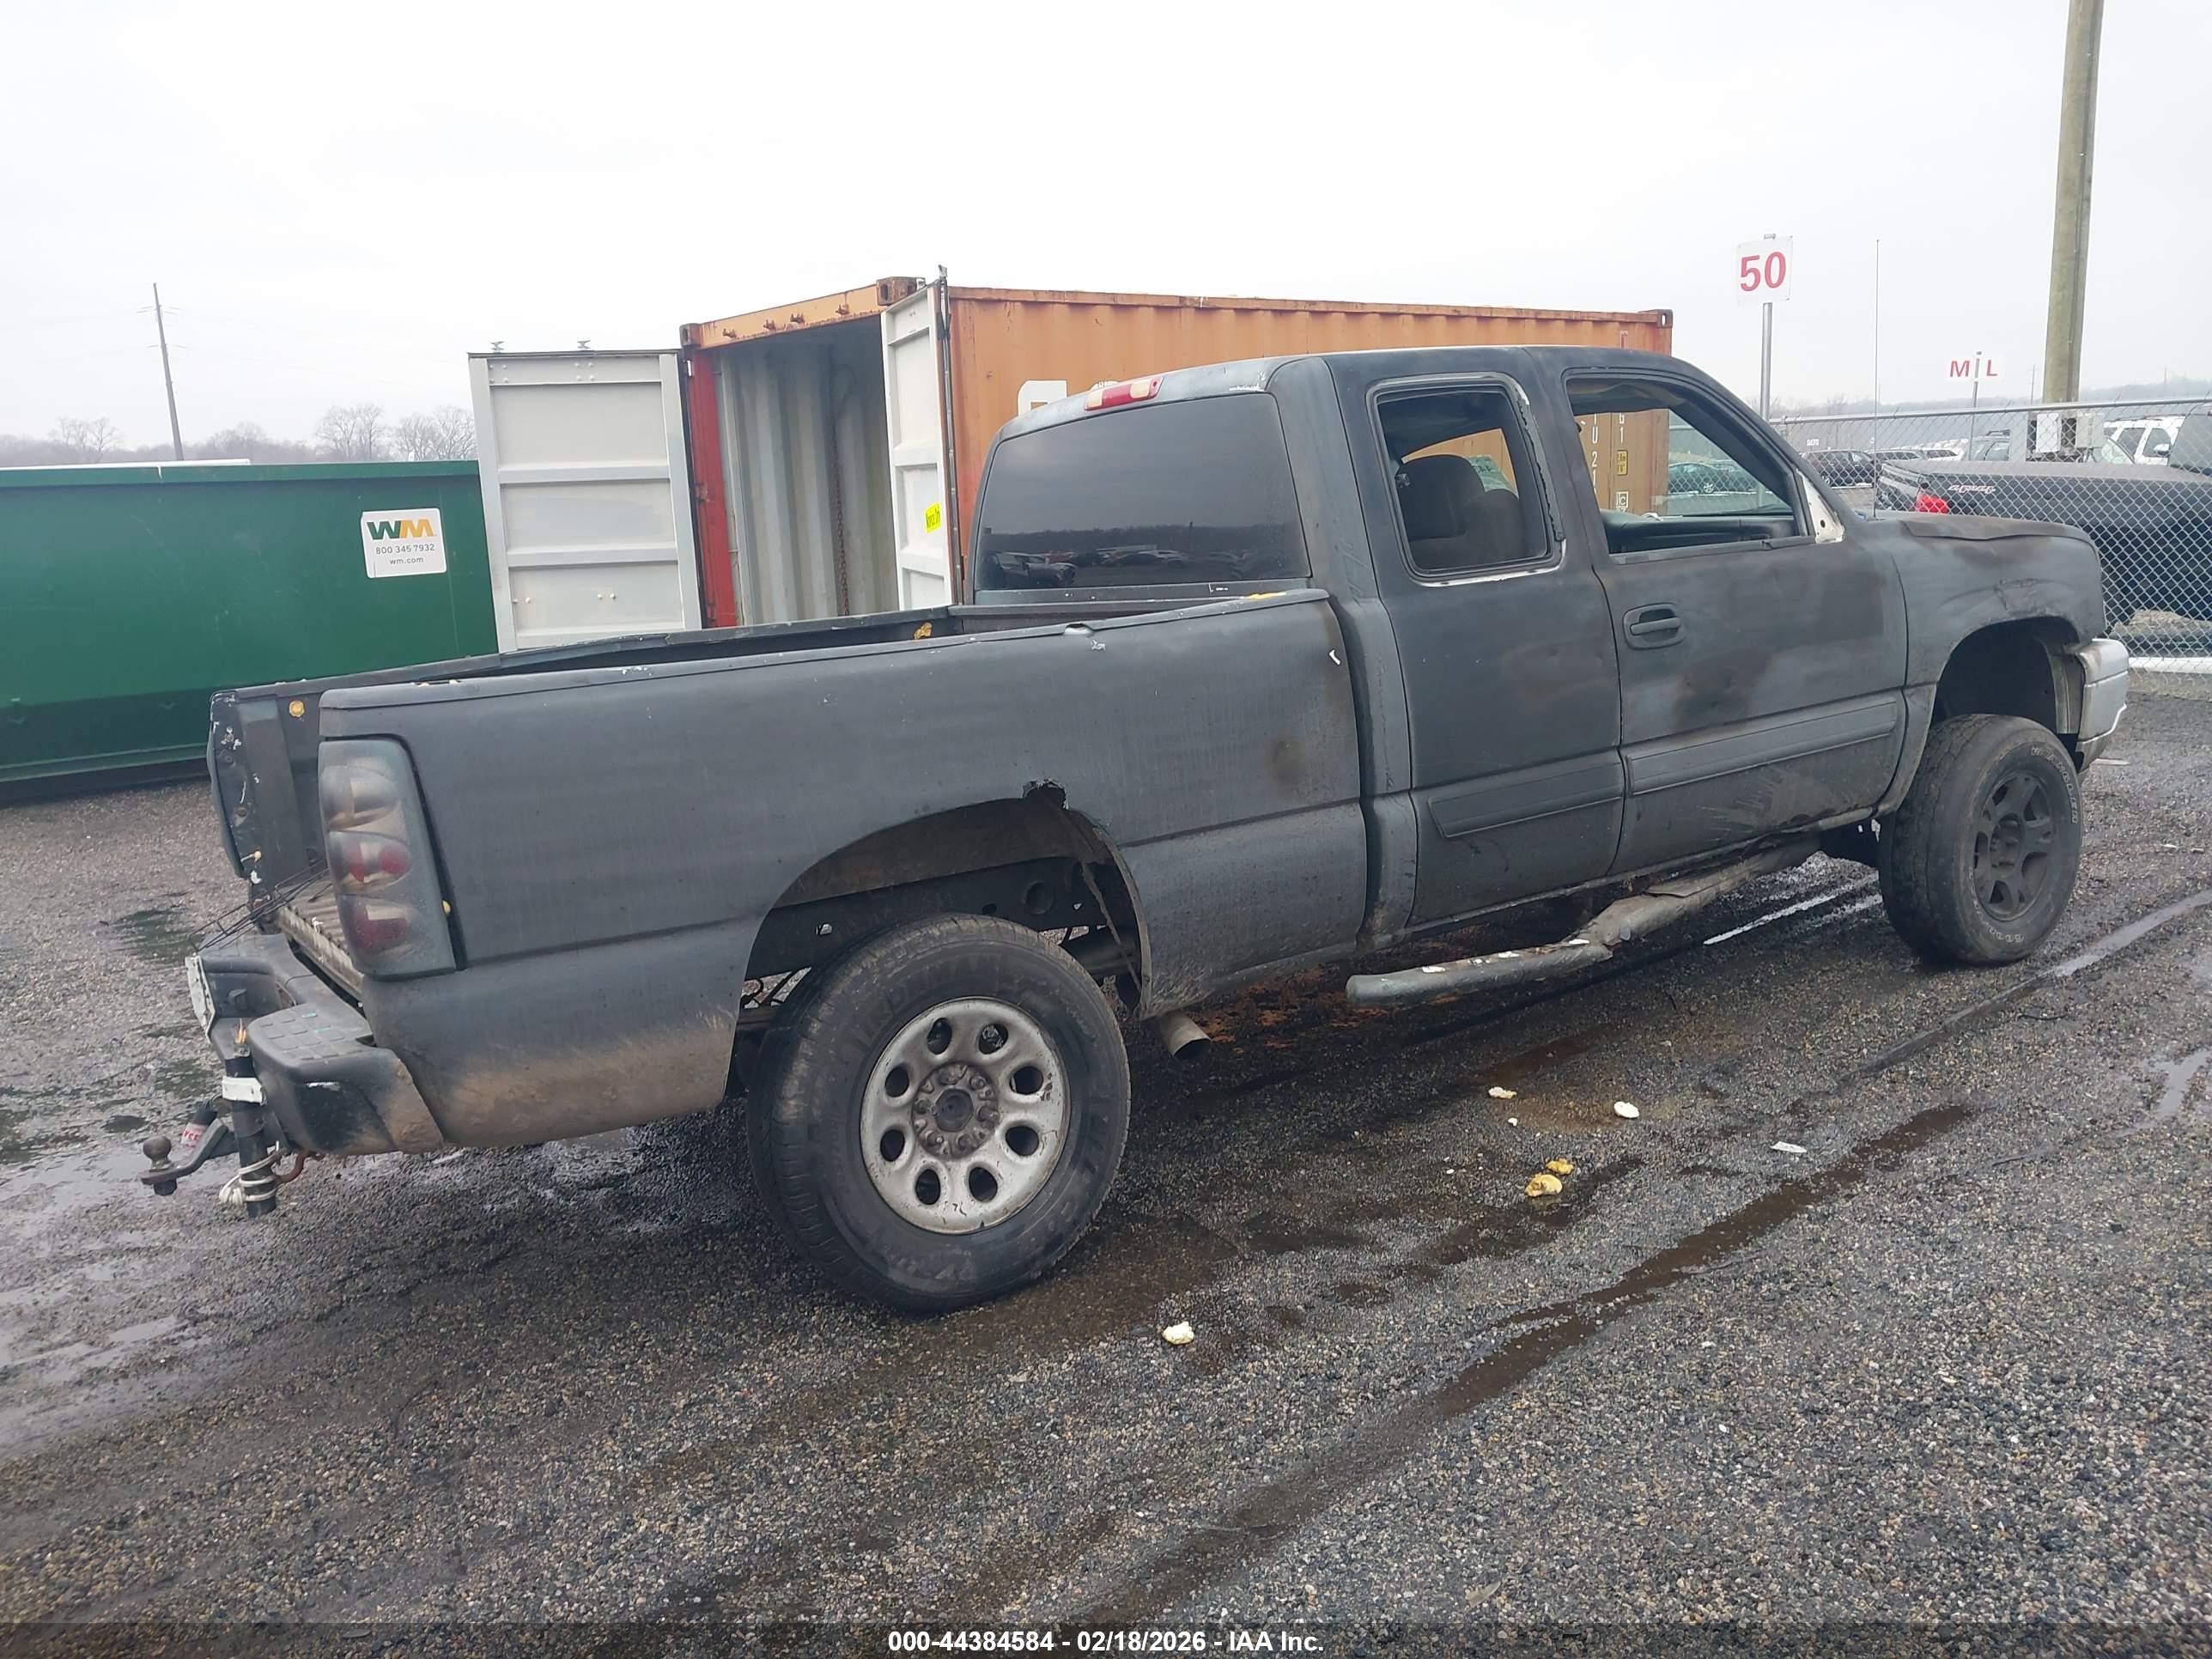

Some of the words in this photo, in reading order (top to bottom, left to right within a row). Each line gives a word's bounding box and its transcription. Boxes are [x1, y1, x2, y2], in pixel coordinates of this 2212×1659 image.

[1740, 251, 1786, 292] 50
[1950, 360, 1971, 378] M
[1986, 359, 1998, 377] L
[367, 519, 434, 540] WM
[395, 544, 412, 554] 345
[413, 544, 434, 552] 7932
